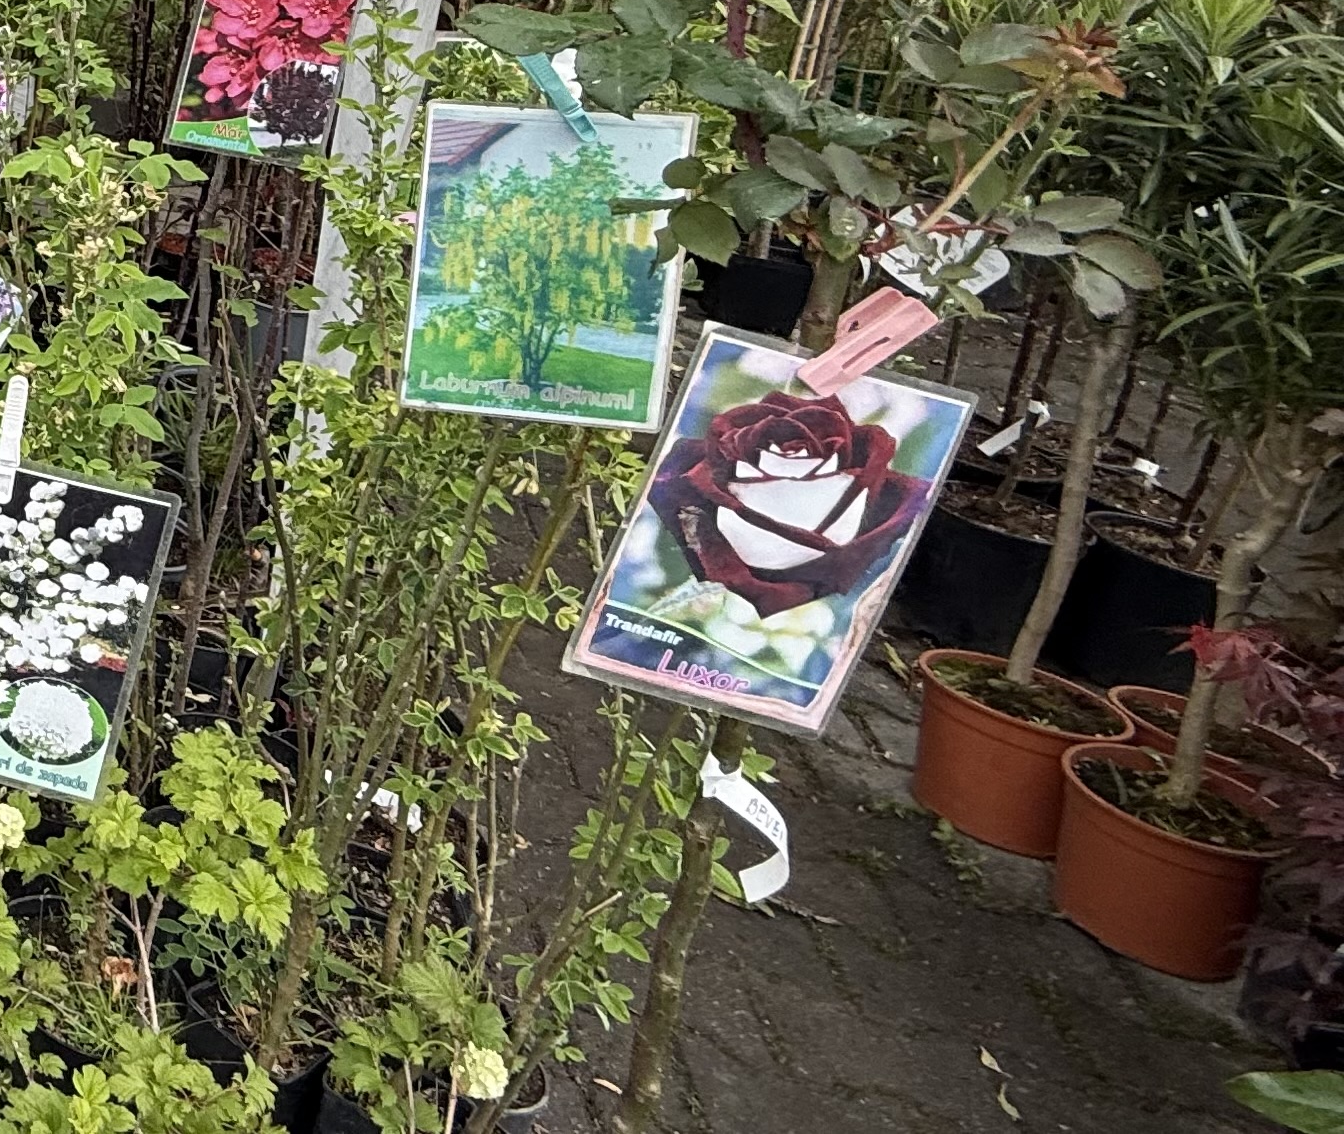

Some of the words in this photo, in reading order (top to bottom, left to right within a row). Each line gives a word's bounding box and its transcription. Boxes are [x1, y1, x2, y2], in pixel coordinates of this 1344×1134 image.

[419, 369, 531, 400] Laburnum
[605, 613, 684, 646] Trandafir
[657, 648, 751, 692] Luxor
[15, 760, 34, 777] de
